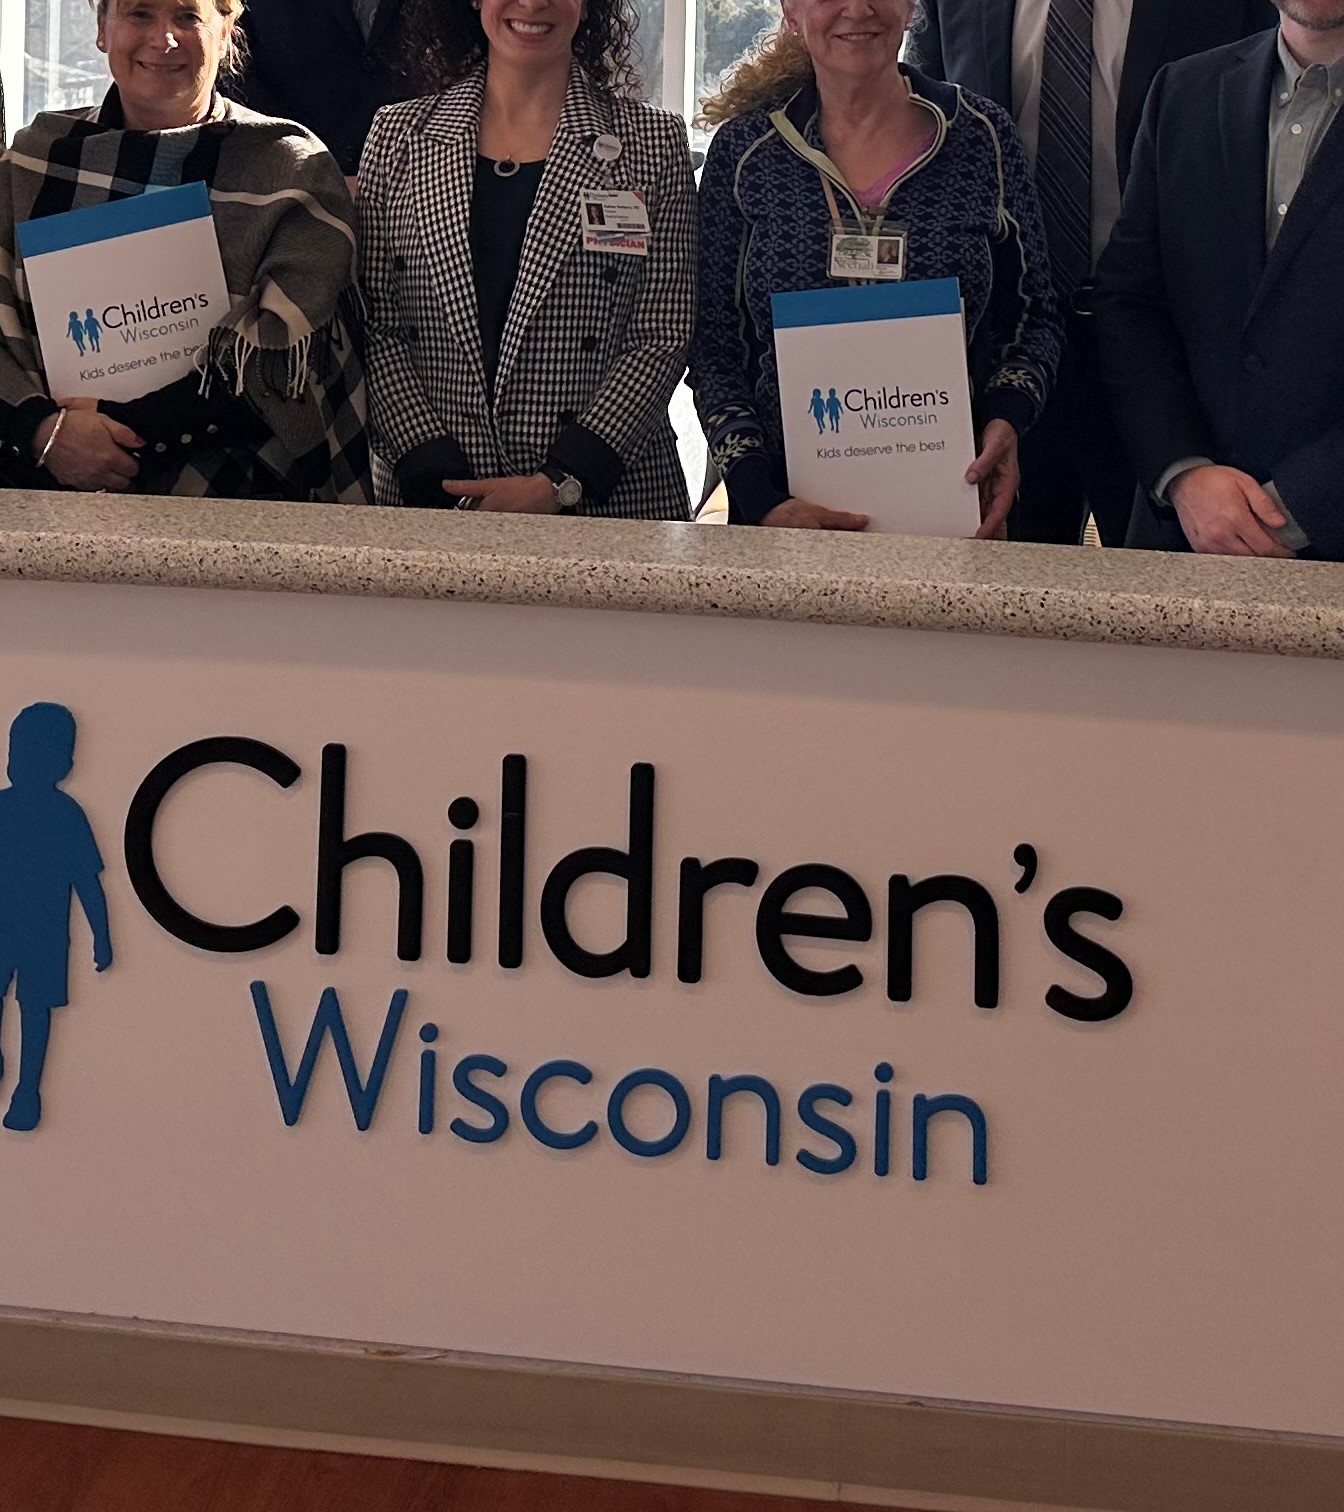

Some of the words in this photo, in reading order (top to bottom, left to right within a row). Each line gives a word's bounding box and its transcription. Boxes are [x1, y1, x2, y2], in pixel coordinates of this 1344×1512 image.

[102, 293, 209, 329] Children's
[119, 317, 200, 344] Wisconsin
[80, 367, 105, 381] Kids
[107, 355, 157, 375] deserve
[159, 350, 181, 362] the
[844, 386, 949, 412] Children's
[859, 413, 938, 429] Wisconsin
[817, 447, 841, 459] Kids
[844, 445, 892, 458] deserve
[896, 442, 916, 453] the
[920, 440, 945, 452] best
[124, 736, 1134, 1022] Children's
[249, 981, 989, 1185] Wisconsin
